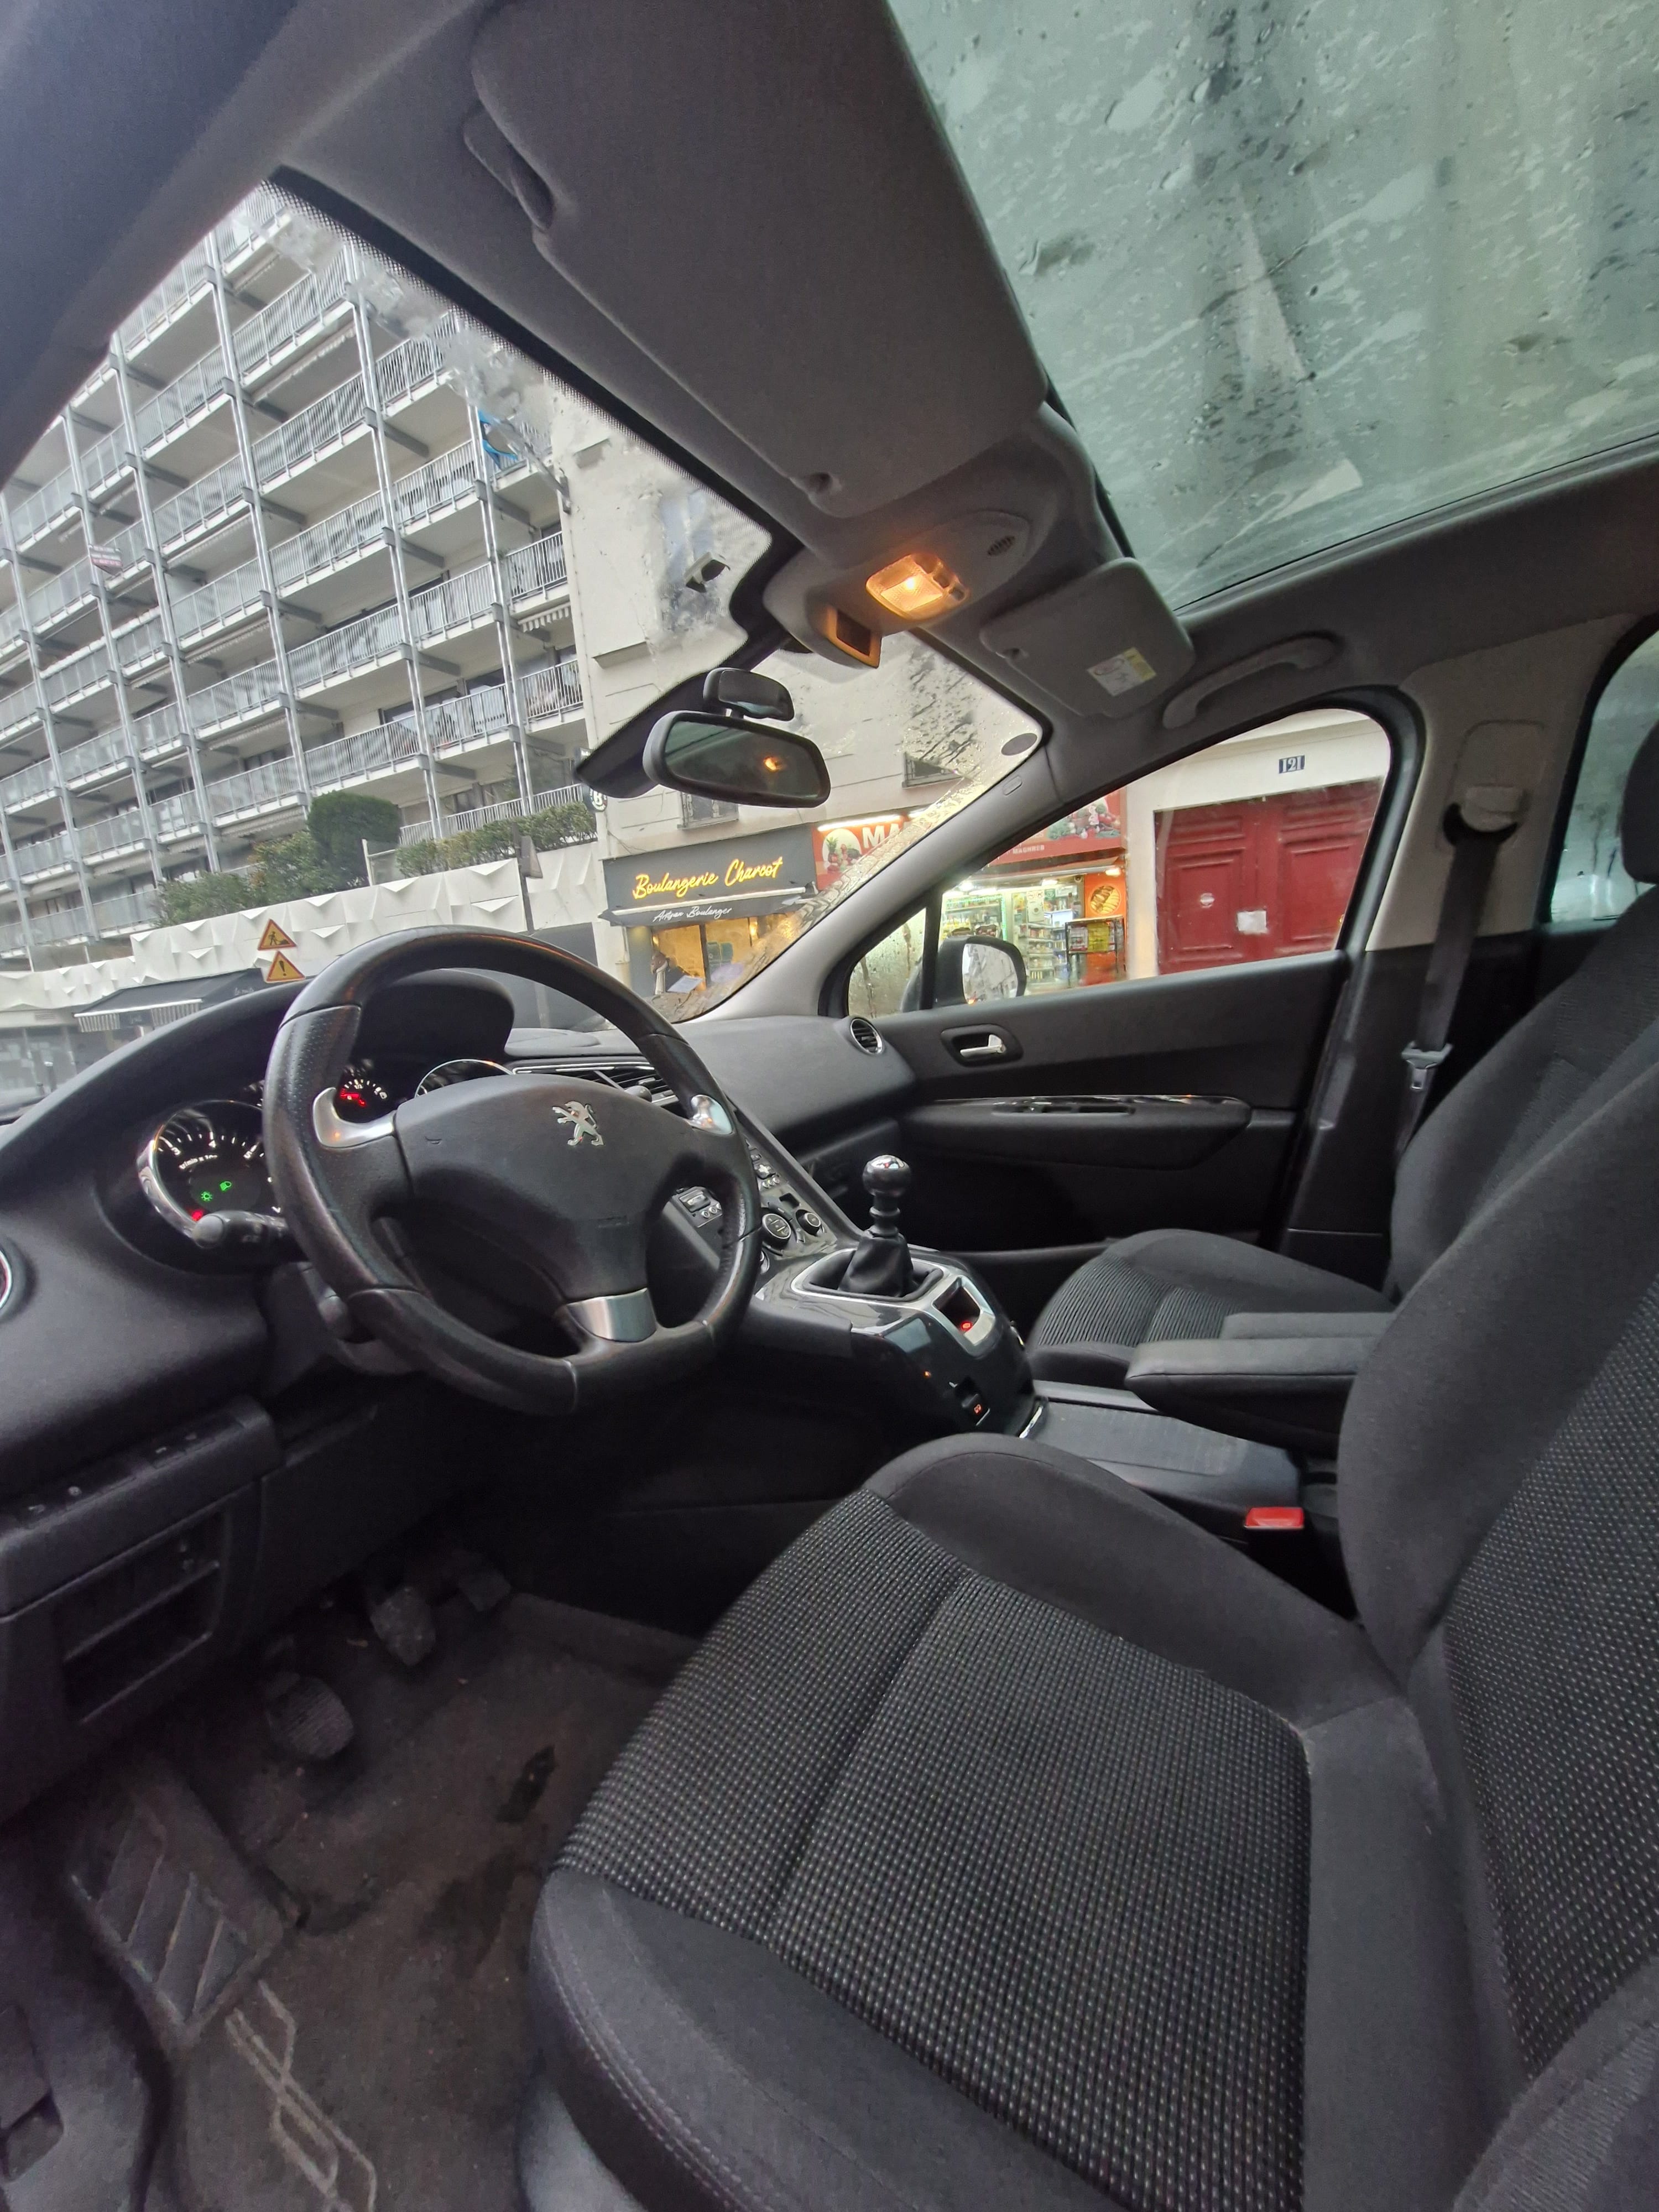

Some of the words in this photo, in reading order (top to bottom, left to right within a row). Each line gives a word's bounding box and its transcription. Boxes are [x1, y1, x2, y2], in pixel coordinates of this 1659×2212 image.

[1282, 756, 1301, 773] 121
[632, 872, 719, 900] Boulangerie
[724, 856, 784, 886] Charcot
[653, 910, 685, 922] Artisan
[686, 906, 733, 920] Boulanger
[208, 1140, 216, 1149] 4
[171, 1147, 181, 1156] 3
[243, 1150, 253, 1159] 5
